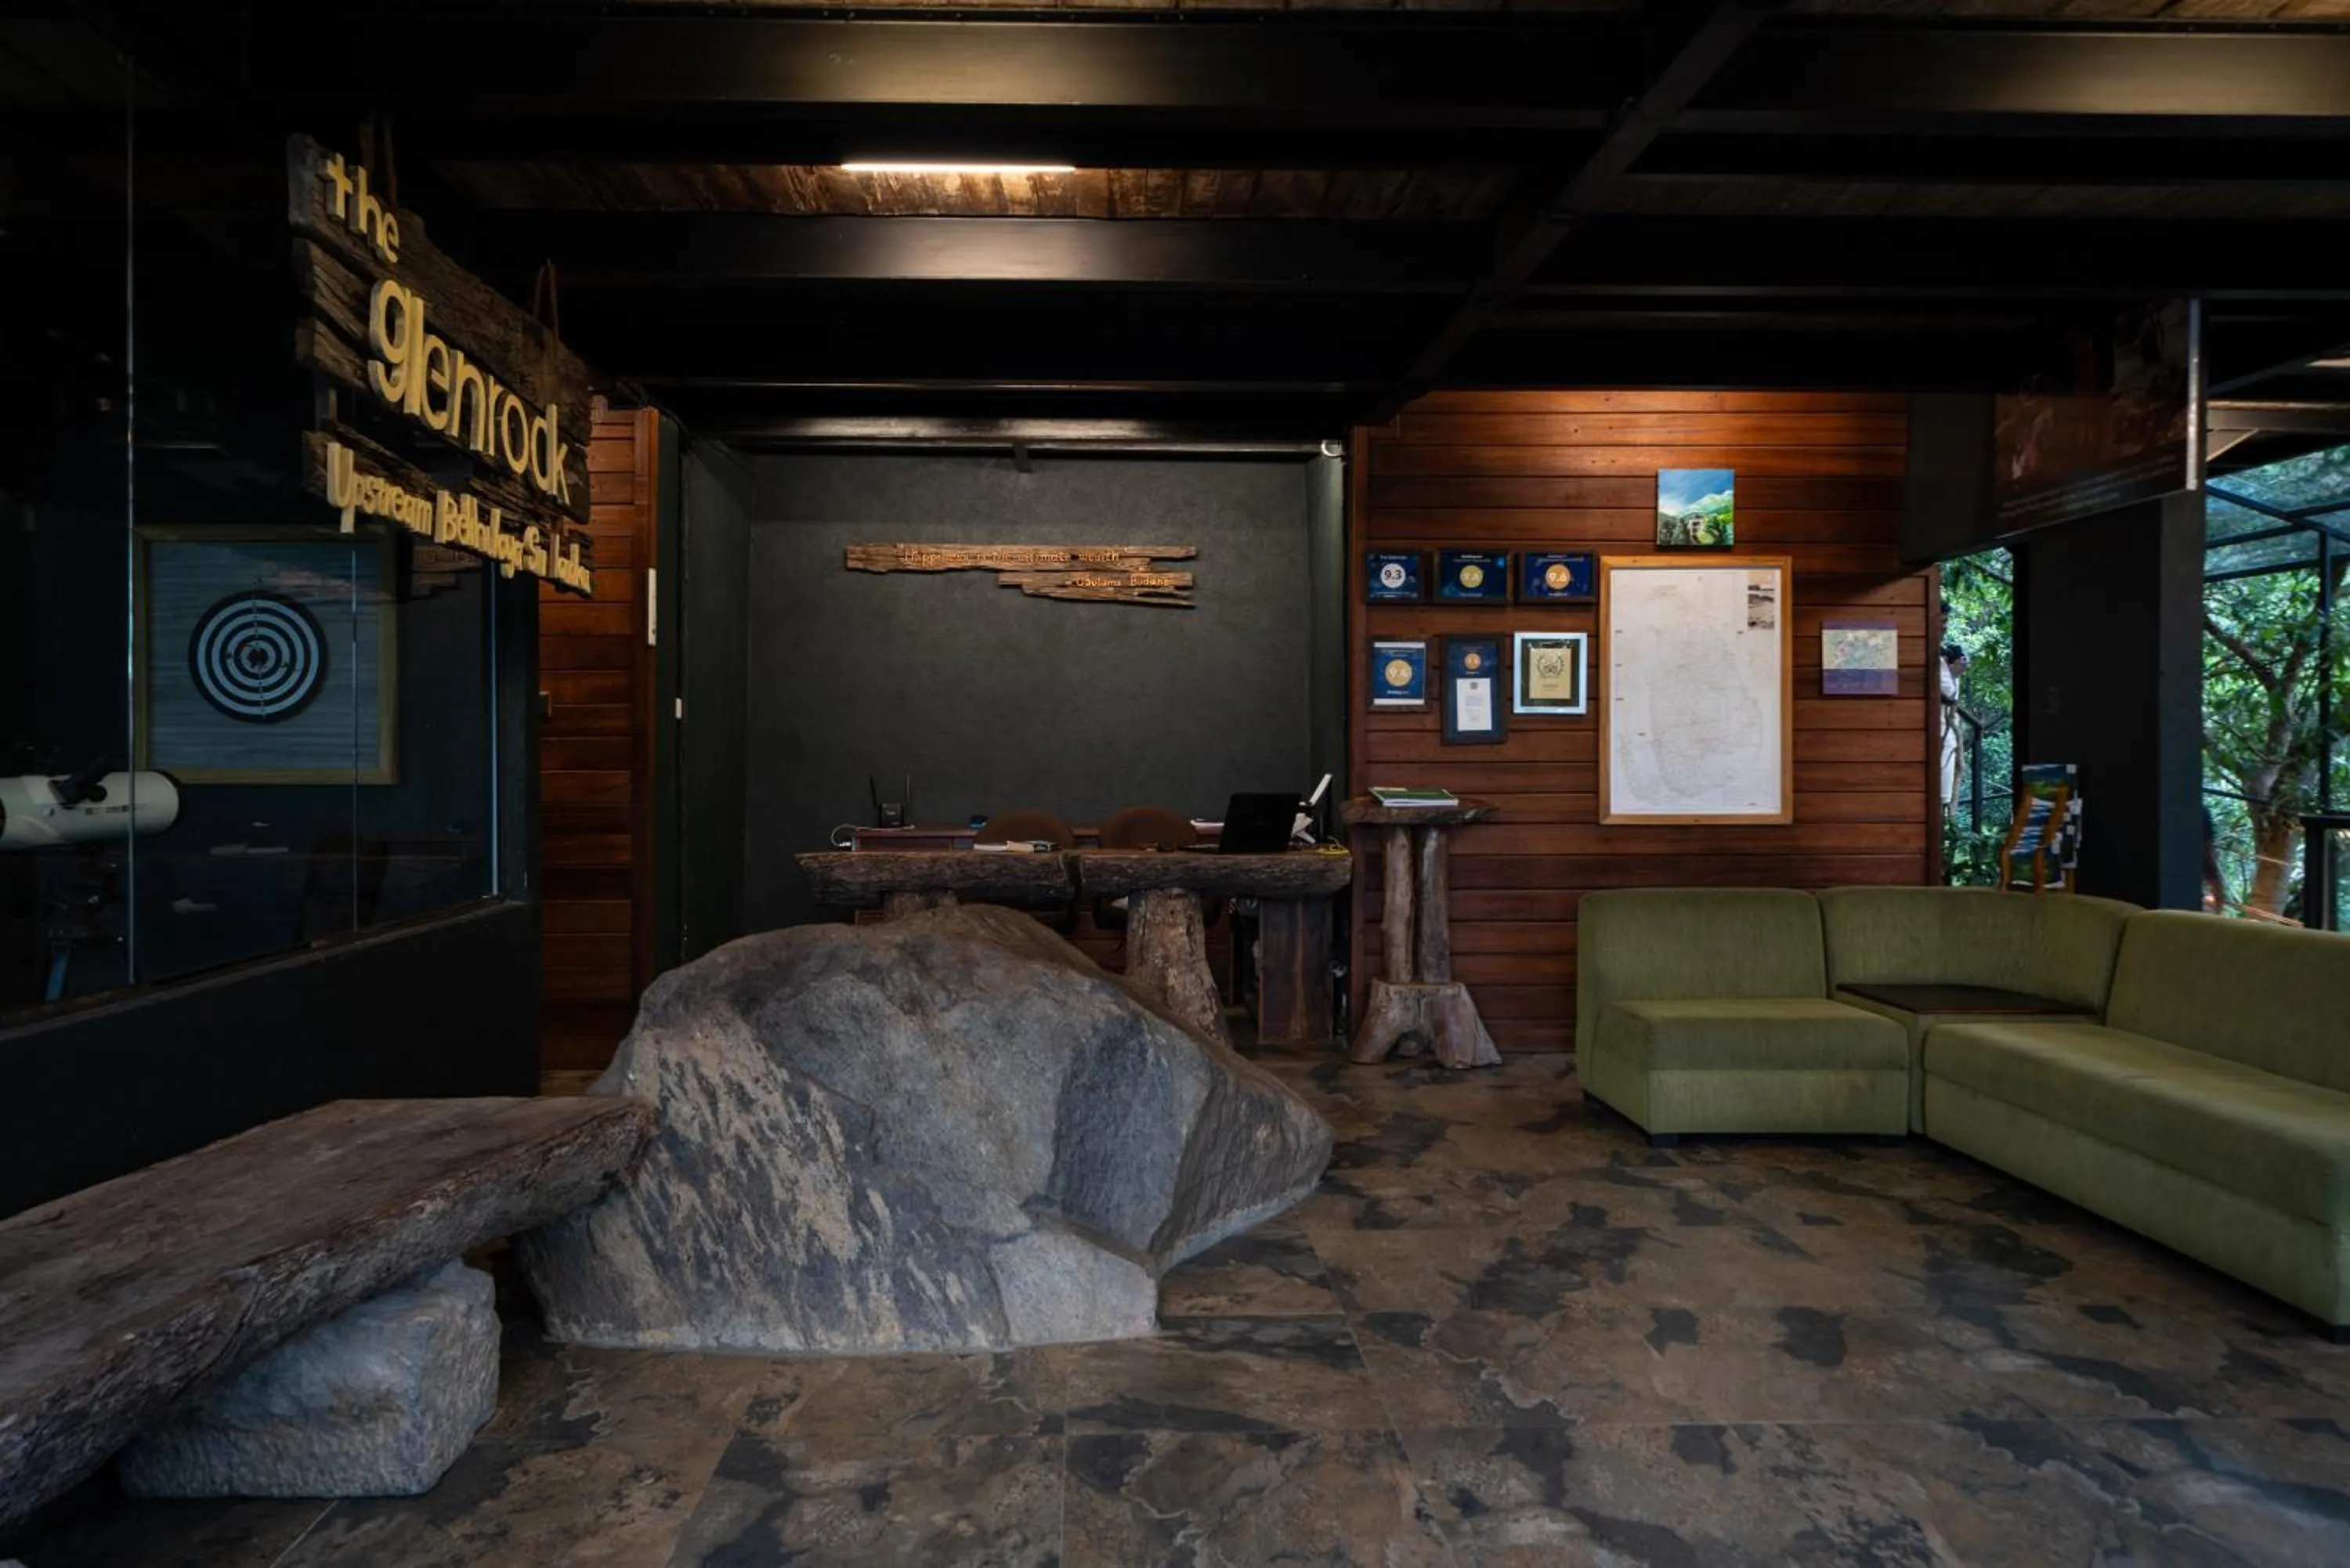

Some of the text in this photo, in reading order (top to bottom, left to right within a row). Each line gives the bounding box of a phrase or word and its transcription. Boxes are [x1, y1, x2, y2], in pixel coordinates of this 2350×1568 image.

[326, 153, 400, 263] the
[367, 280, 570, 507] glenrock
[327, 441, 433, 537] Upstream
[1384, 569, 1402, 580] 9.3
